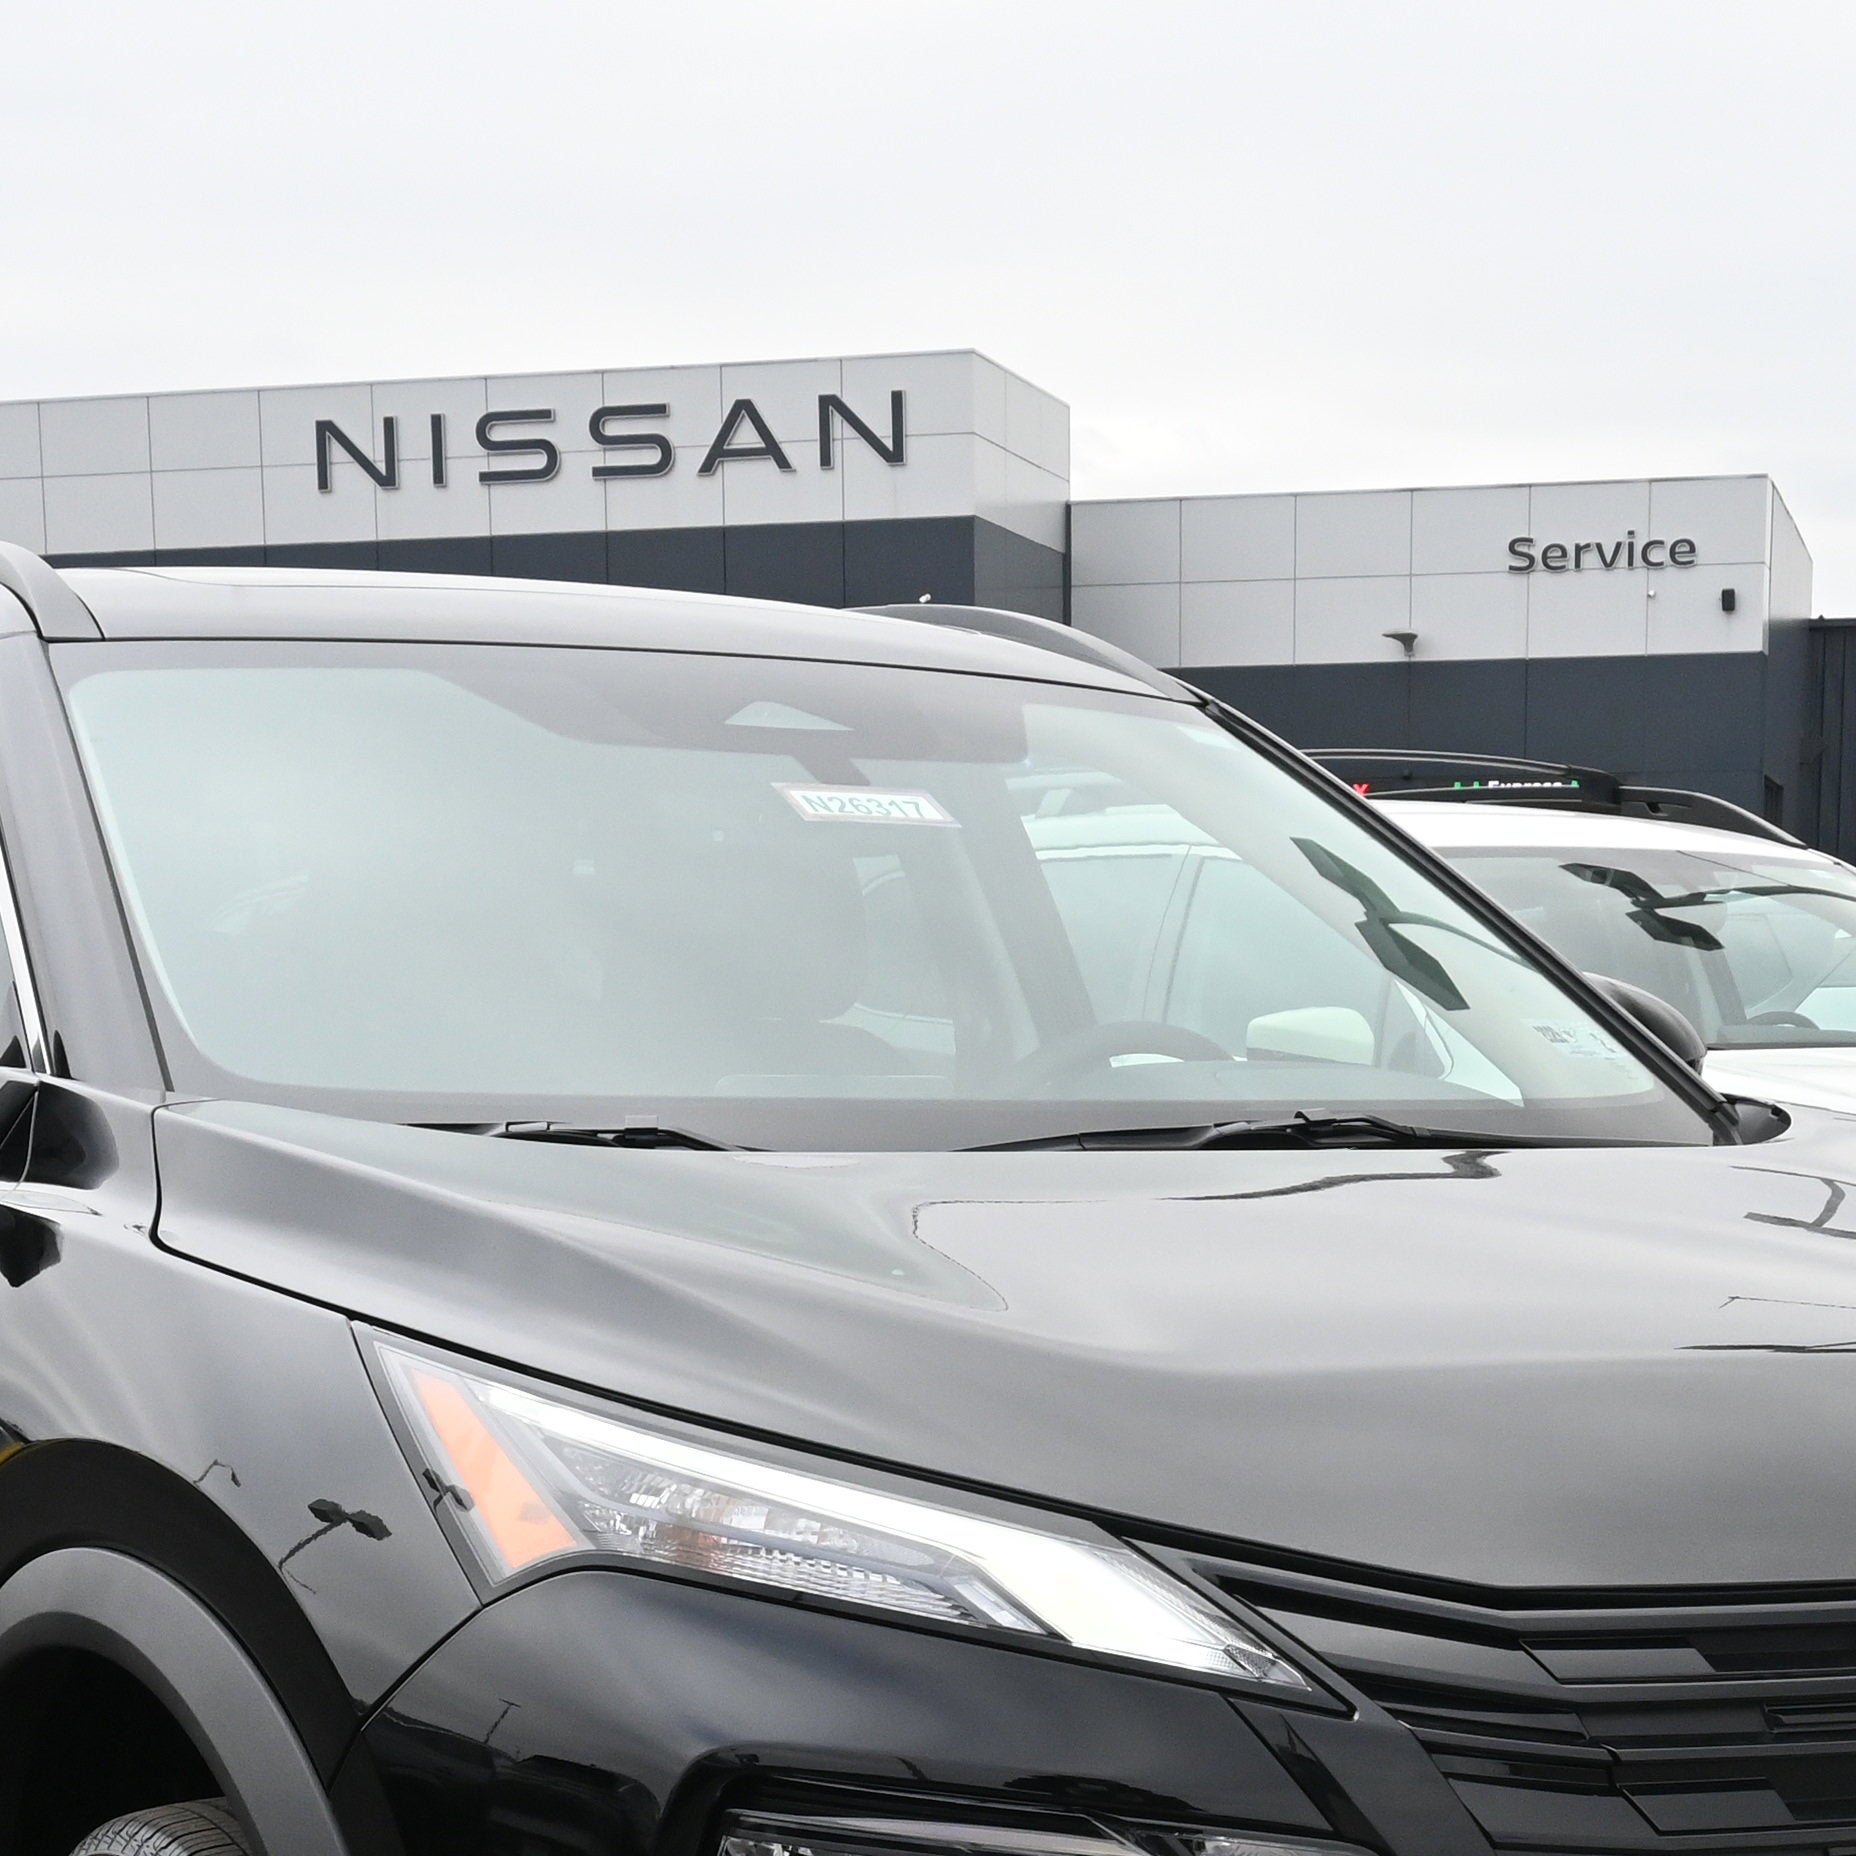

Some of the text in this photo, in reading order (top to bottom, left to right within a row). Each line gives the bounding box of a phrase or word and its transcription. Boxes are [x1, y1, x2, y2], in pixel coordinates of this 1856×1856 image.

[314, 389, 907, 494] NISSAN
[1507, 529, 1697, 574] Service
[802, 795, 924, 818] N26317
